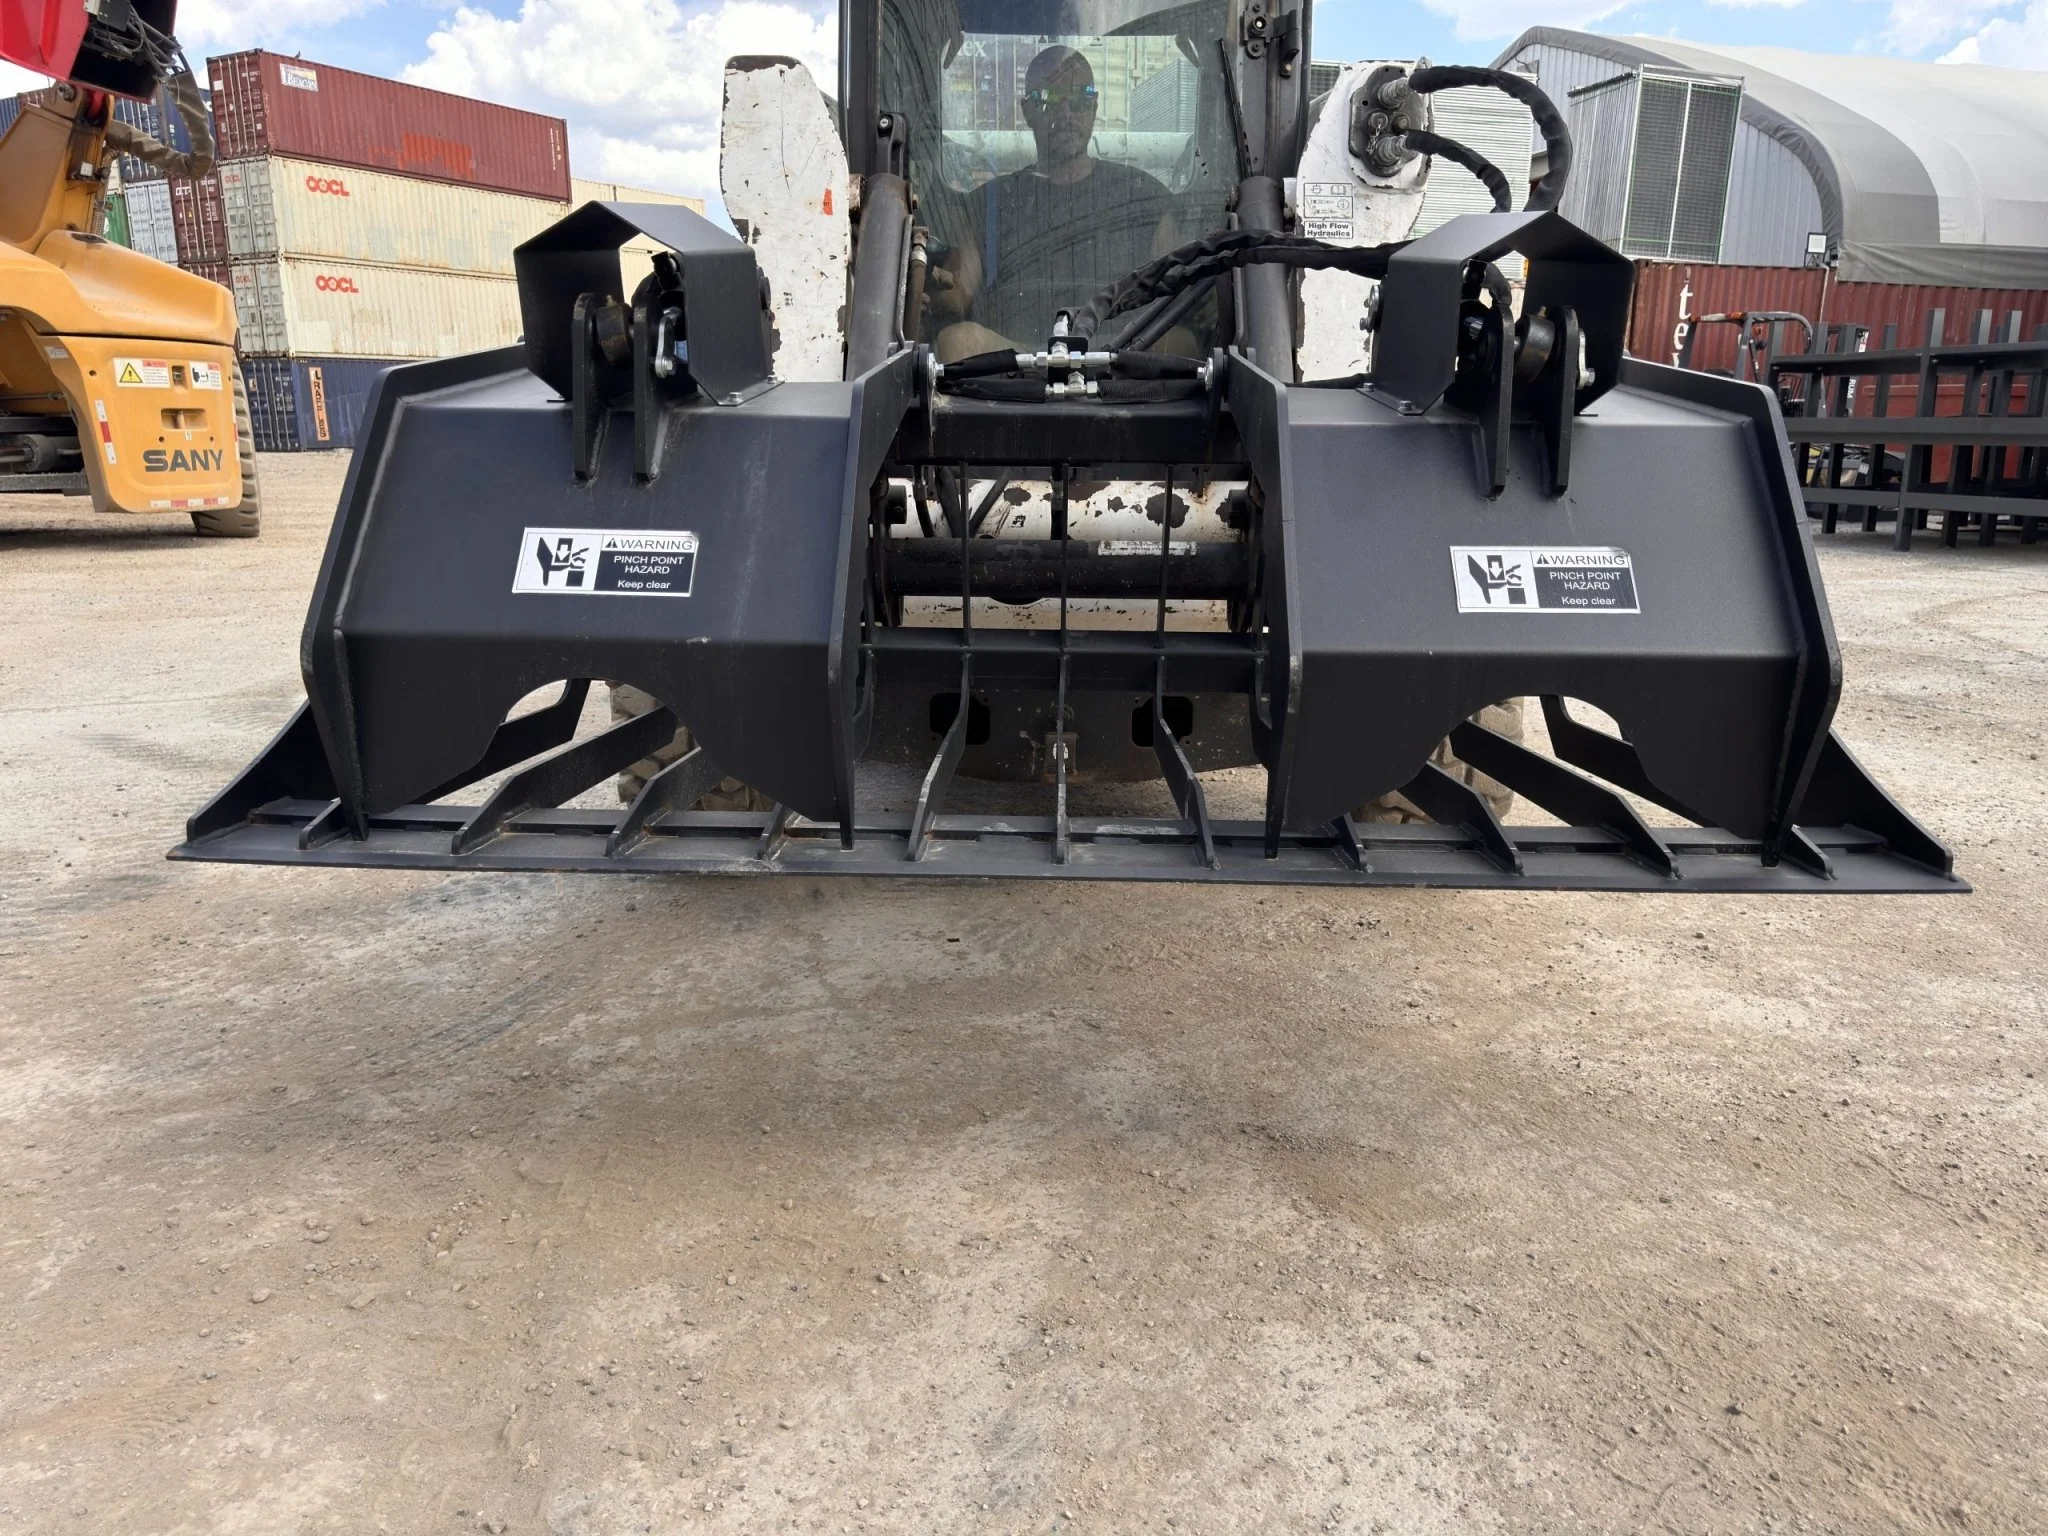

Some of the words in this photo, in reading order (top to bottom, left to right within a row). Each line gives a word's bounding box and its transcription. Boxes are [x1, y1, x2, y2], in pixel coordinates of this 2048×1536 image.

[306, 175, 350, 197] OOCL
[316, 274, 359, 293] OOCL
[142, 449, 223, 472] SANY
[620, 539, 693, 550] WARNING
[613, 555, 648, 565] PINCH
[650, 556, 684, 565] POINT
[1550, 555, 1625, 565] WARNING
[624, 565, 670, 574] HAZARD
[1550, 571, 1585, 580] PINCH
[1587, 571, 1621, 580] POINT
[617, 580, 644, 590] Keep
[645, 580, 671, 589] clear
[1564, 581, 1610, 590] HAZARD
[1561, 596, 1588, 606] Keep
[1591, 596, 1615, 605] clear
